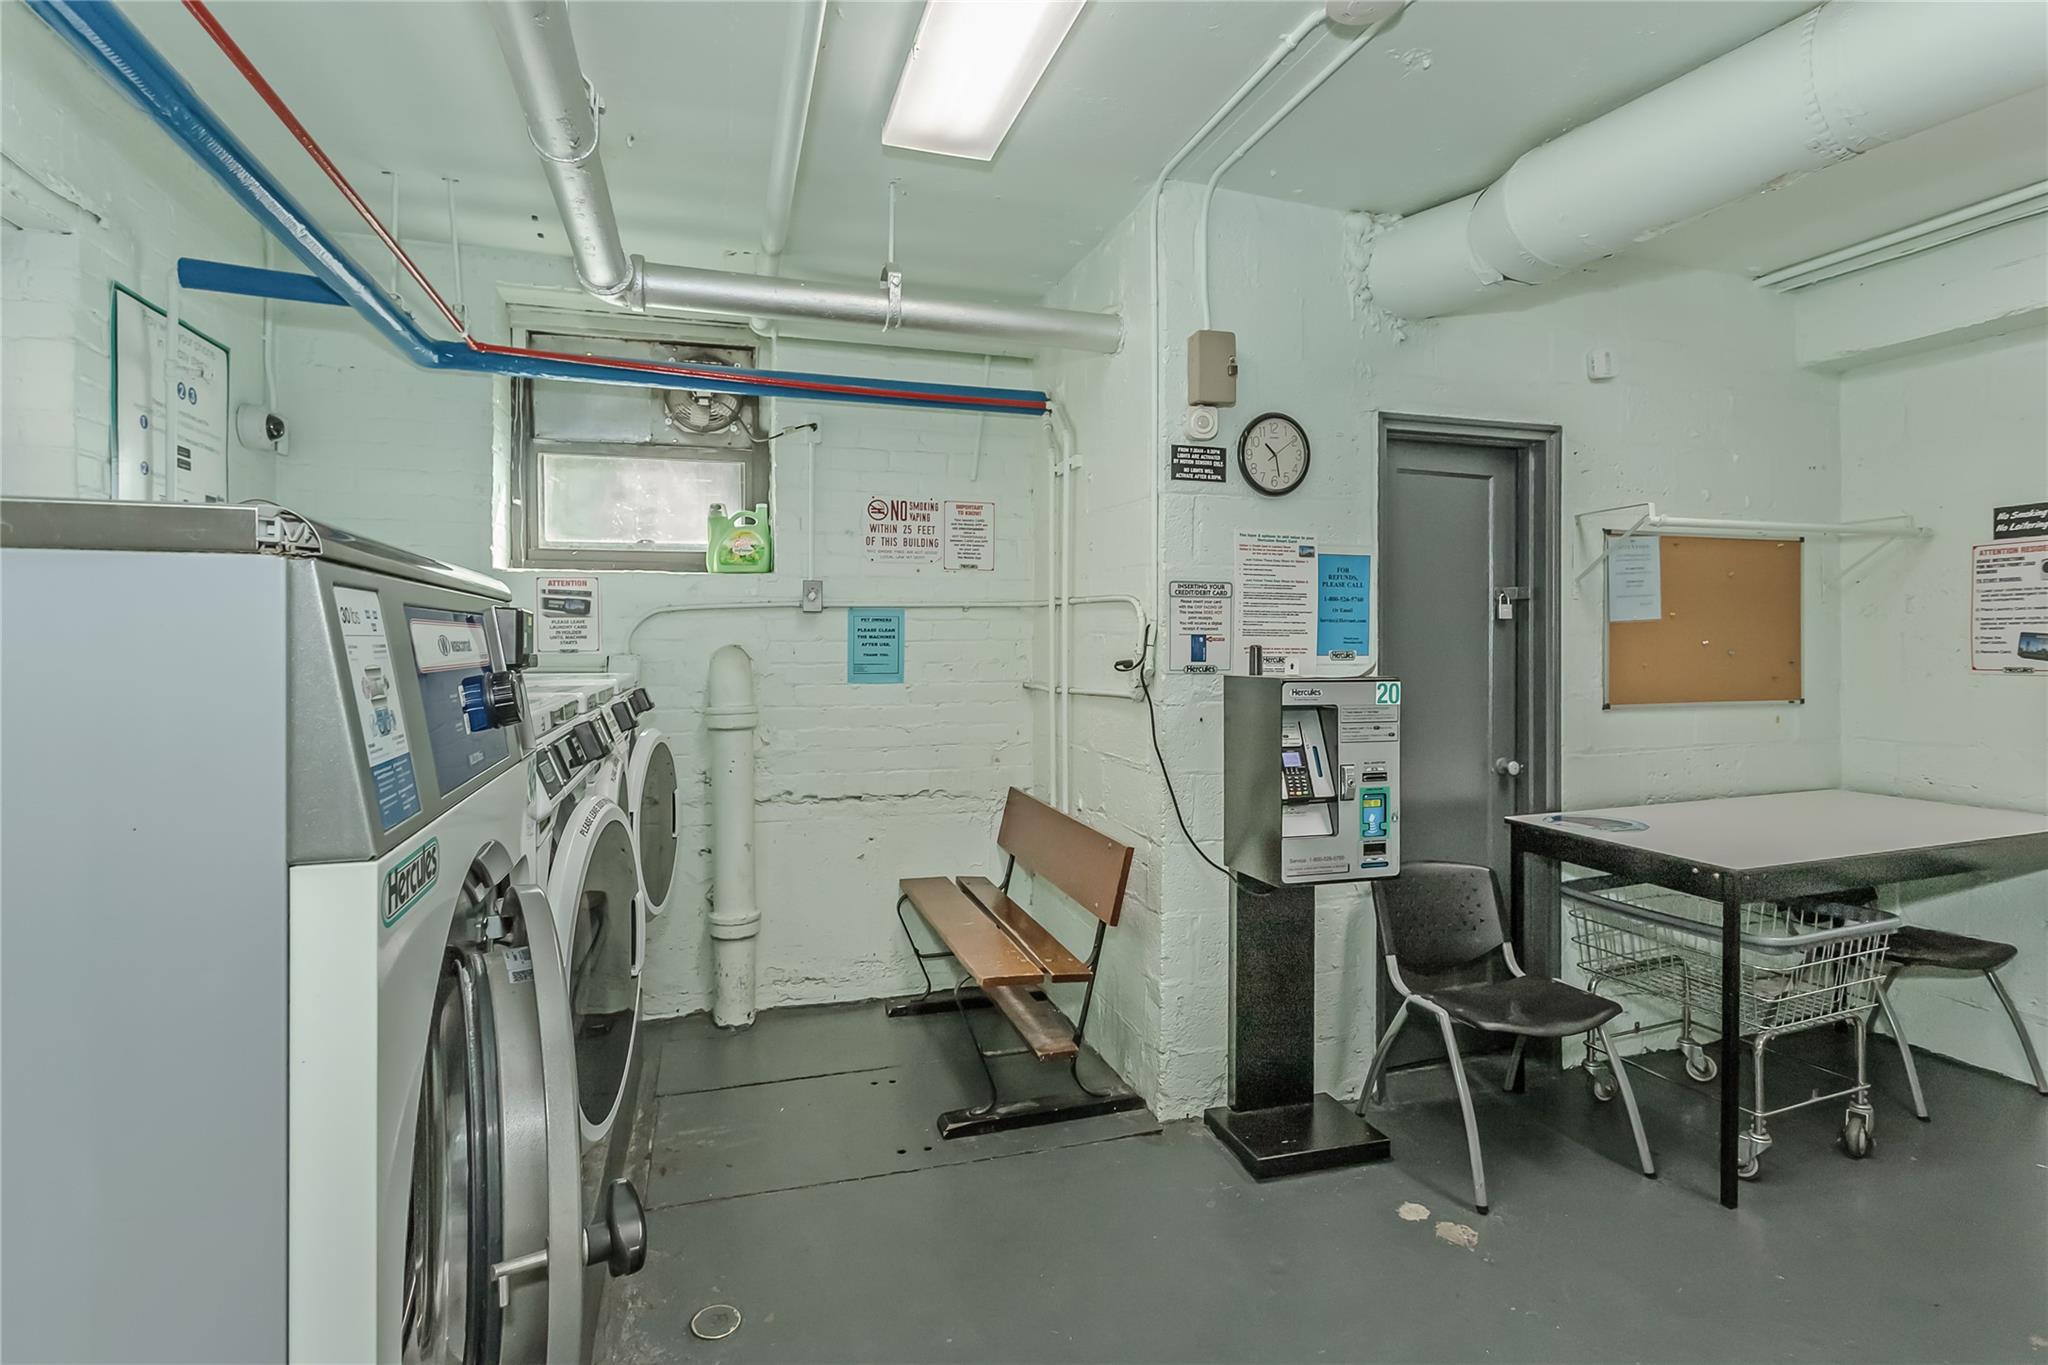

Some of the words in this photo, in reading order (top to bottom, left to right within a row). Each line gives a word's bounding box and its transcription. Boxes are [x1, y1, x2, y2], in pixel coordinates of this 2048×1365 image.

[1259, 426, 1265, 437] 11
[1269, 422, 1278, 434] 12
[1284, 425, 1287, 436] 1
[1249, 436, 1260, 448] 10
[1291, 435, 1298, 447] 2
[1246, 448, 1253, 460] 9
[1296, 449, 1302, 461] 3
[1251, 463, 1257, 474] 8
[1292, 464, 1298, 473] 4
[1260, 472, 1266, 482] 7
[1271, 476, 1278, 487] 6
[1283, 472, 1289, 484] 5
[891, 500, 907, 521] NO
[909, 501, 938, 512] SMOKING
[1997, 512, 2009, 520] No
[2010, 509, 2048, 519] Smoking
[909, 513, 930, 522] VAPING
[870, 524, 897, 533] WITHIN
[903, 525, 912, 534] 25
[918, 525, 935, 535] FEET
[1996, 524, 2008, 532] No
[2009, 521, 2048, 531] Loitering
[866, 536, 875, 546] OF
[881, 537, 898, 546] THIS
[903, 538, 939, 548] BUILDING
[340, 606, 350, 624] 30
[1377, 683, 1399, 704] 20
[580, 816, 593, 837] PLEASE
[388, 844, 437, 915] Hercules
